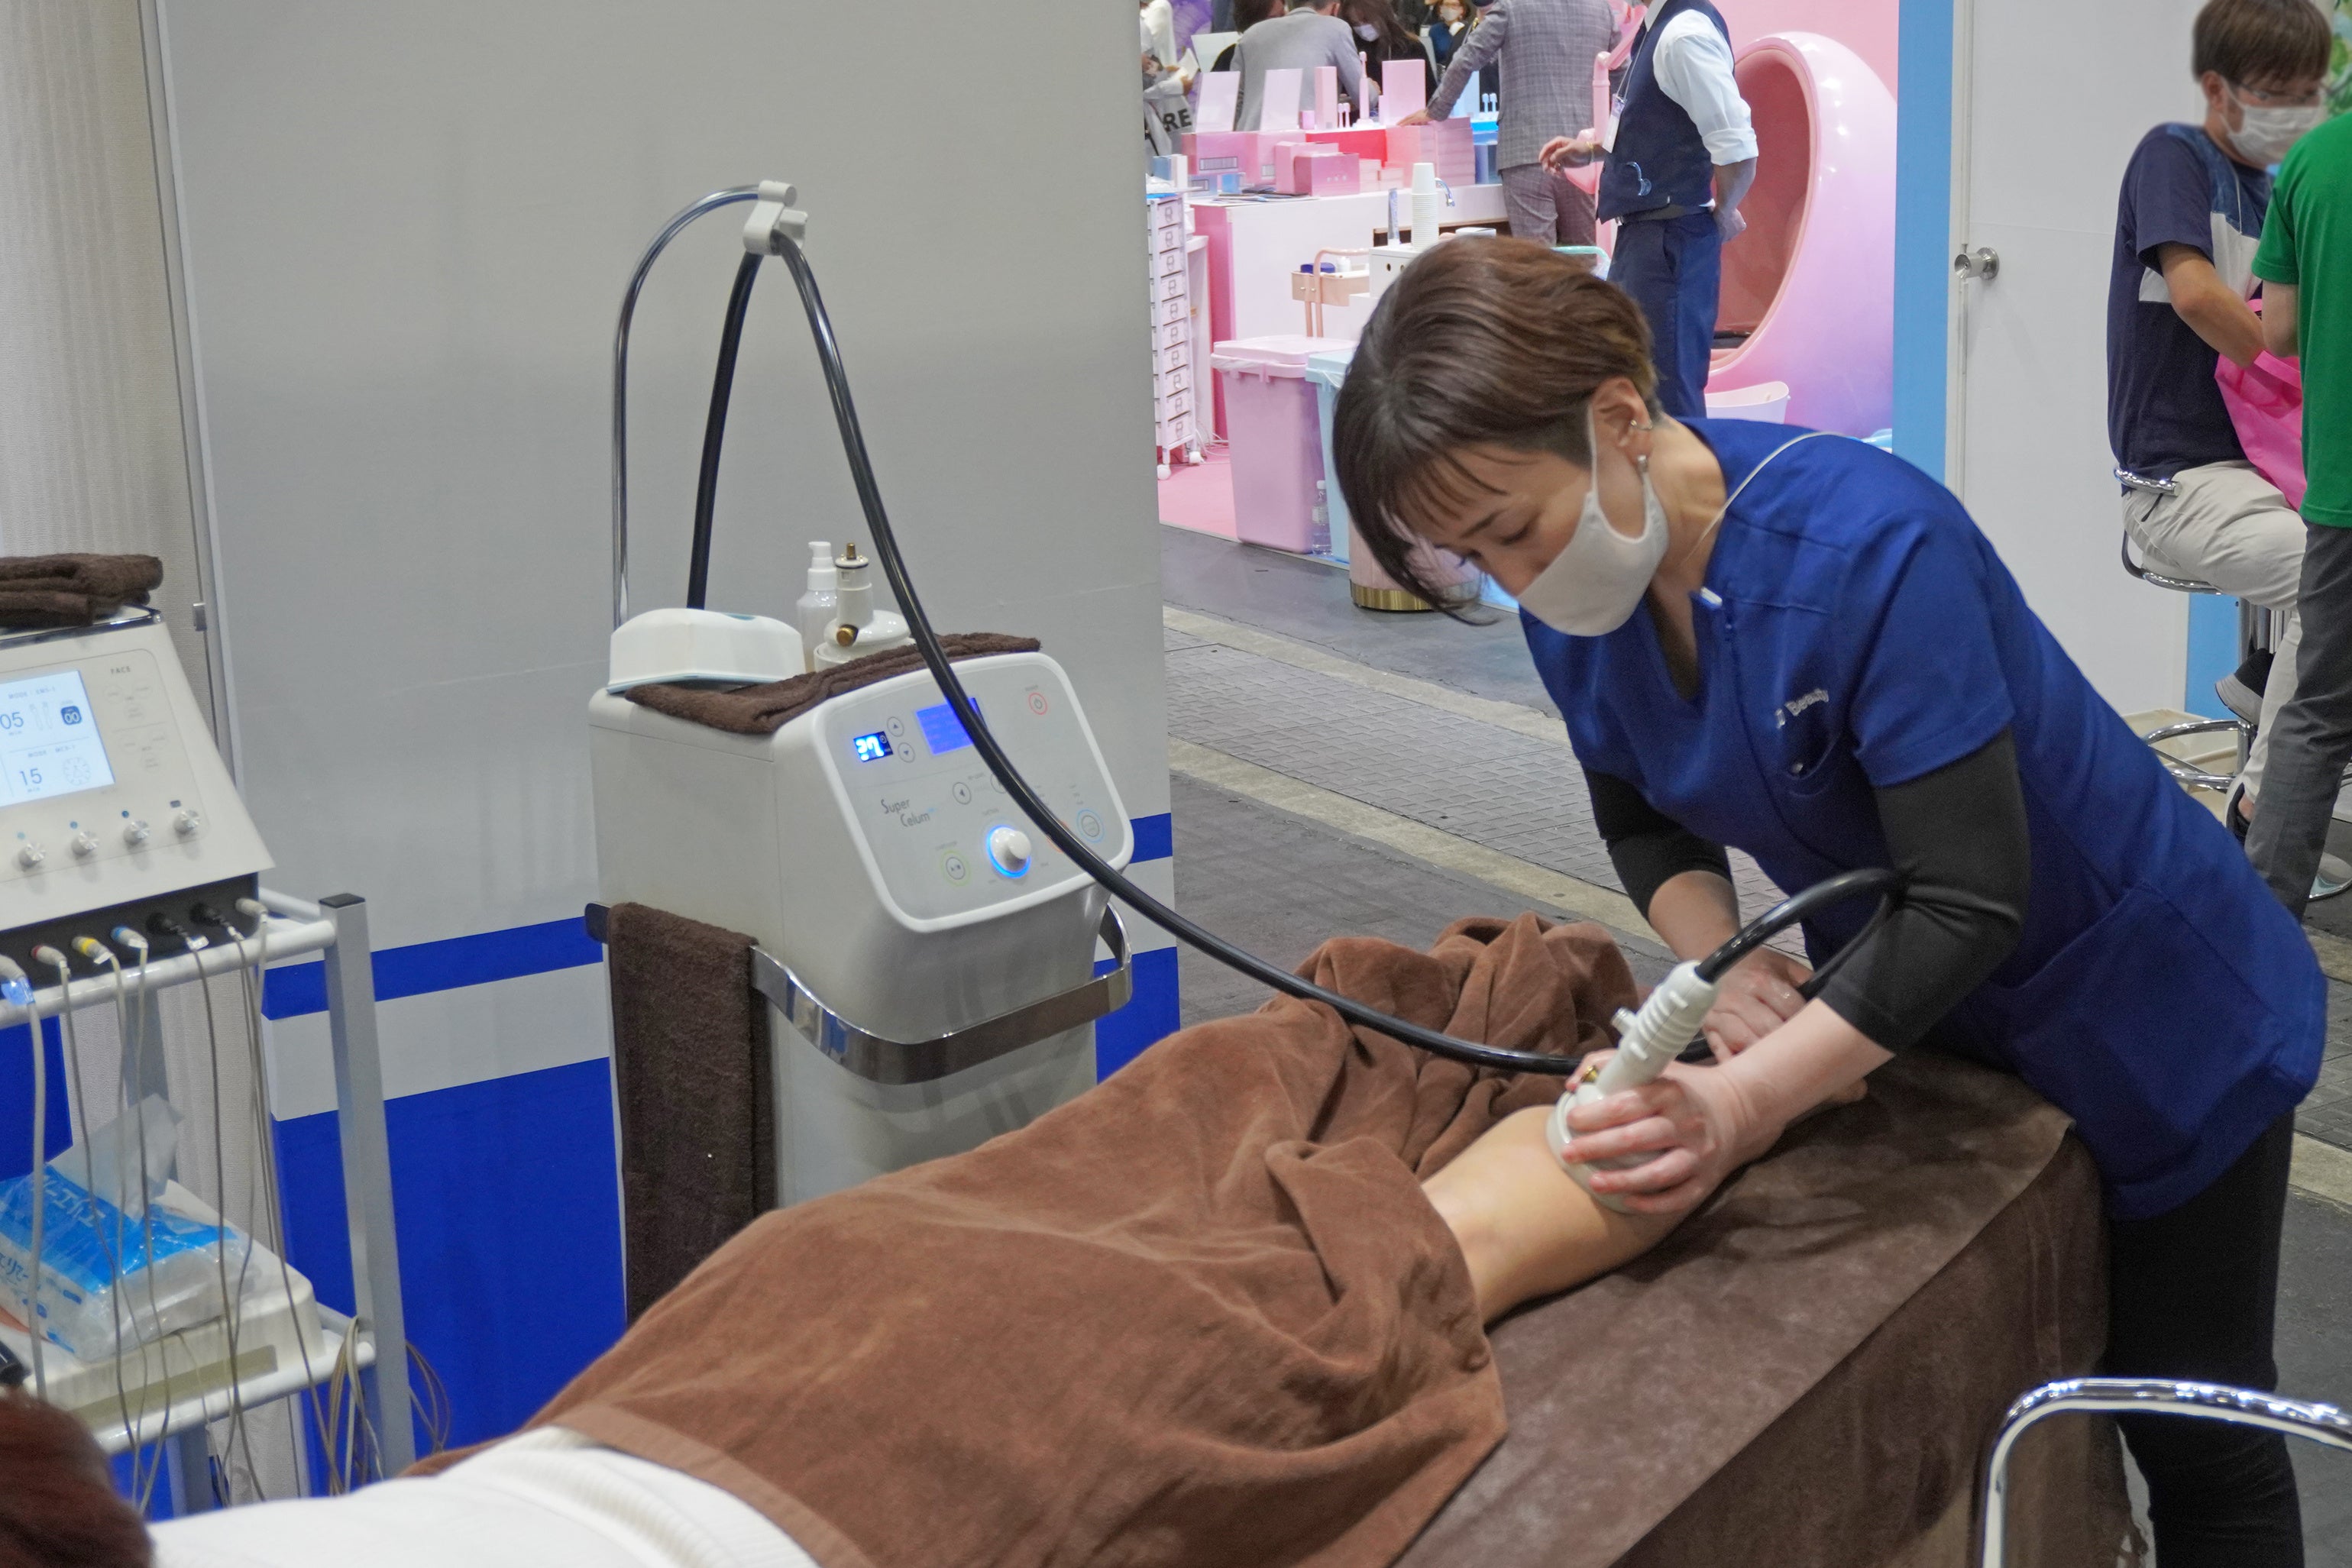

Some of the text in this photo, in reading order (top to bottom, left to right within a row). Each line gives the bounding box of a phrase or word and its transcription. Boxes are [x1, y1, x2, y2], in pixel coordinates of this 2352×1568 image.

[0, 712, 24, 729] 05
[64, 711, 80, 724] 00
[19, 768, 42, 786] 15
[880, 798, 910, 814] Super
[900, 812, 930, 827] Celum
